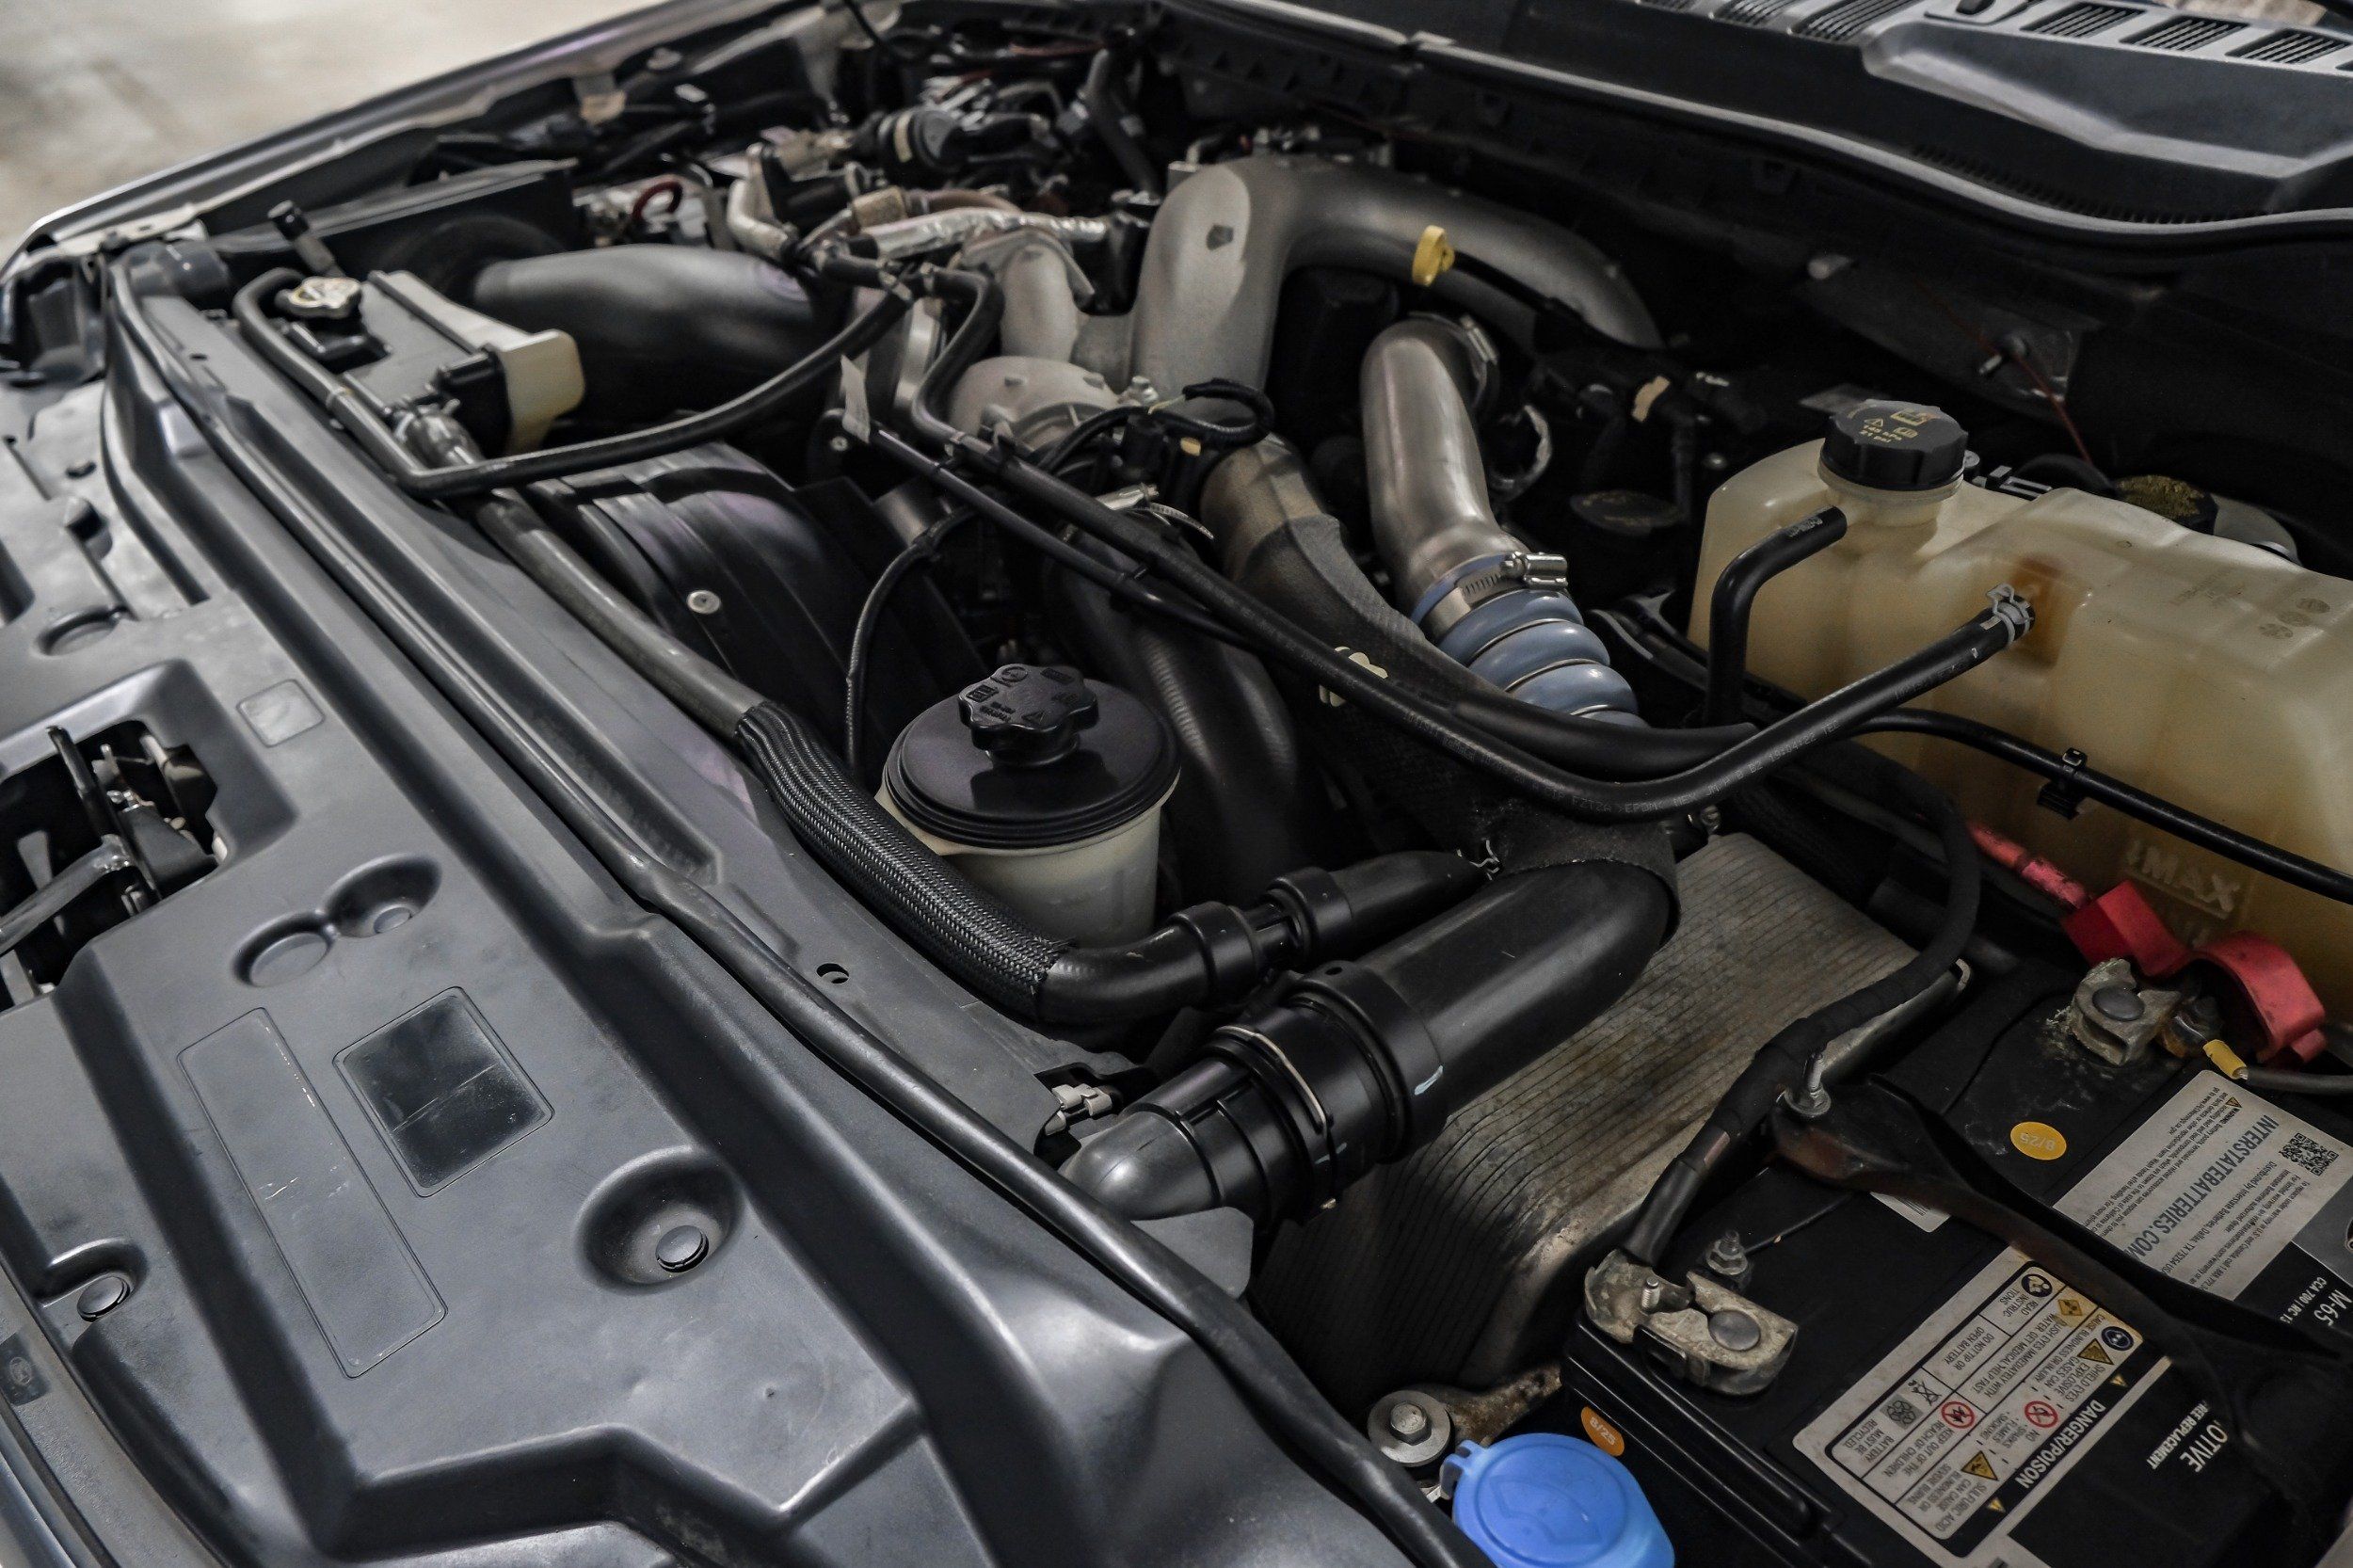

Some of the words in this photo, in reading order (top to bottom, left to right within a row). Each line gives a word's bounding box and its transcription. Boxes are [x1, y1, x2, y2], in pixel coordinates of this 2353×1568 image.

[2249, 1160, 2278, 1186] Distributed
[2269, 1169, 2291, 1188] Interstate
[2122, 1114, 2281, 1261] INTERSTATEBATTERIES.COM
[2242, 1181, 2255, 1191] by
[2253, 1185, 2274, 1203] Batteries
[2224, 1188, 2249, 1210] Interstate
[2082, 1213, 2097, 1226] inform
[2182, 1241, 2195, 1252] TX
[2168, 1248, 2187, 1265] 75254
[2310, 1277, 2327, 1291] CCA
[2299, 1289, 2315, 1304] 700
[2019, 1299, 2039, 1316] READ
[2288, 1304, 2302, 1316] RC
[2313, 1289, 2353, 1326] M-65
[2085, 1313, 2105, 1331] CAUSE
[1965, 1326, 1985, 1342] OPEN
[1981, 1333, 1994, 1343] DO
[2022, 1330, 2039, 1344] GET
[2032, 1335, 2051, 1351] EYES
[2057, 1329, 2089, 1357] BLINDNESS
[1969, 1340, 1986, 1354] NOT
[1999, 1340, 2027, 1366] MEDICAL
[1952, 1359, 1966, 1370] OR
[1961, 1351, 1975, 1362] TIP
[1997, 1347, 2038, 1384] IMMEDIATELY
[1984, 1363, 2004, 1380] HELP
[2055, 1355, 2080, 1377] GASES
[2078, 1363, 2105, 1387] SHIELD
[2043, 1374, 2060, 1389] CAN
[2053, 1362, 2089, 1396] EXPLOSIVE
[1982, 1380, 2004, 1398] WITH
[1919, 1419, 1945, 1442] REACH
[1978, 1413, 2009, 1440] SMOKING
[1991, 1419, 2018, 1444] FLAMES
[1863, 1428, 1885, 1447] MUST
[1912, 1438, 1926, 1448] OF
[1934, 1427, 1955, 1445] KEEP
[2001, 1425, 2026, 1448] SPARKS
[2013, 1398, 2106, 1489] DANGER/POISON
[2024, 1429, 2041, 1443] NO
[2145, 1415, 2197, 1469] REPLACEMENT
[1853, 1444, 1867, 1455] BE
[1922, 1441, 1940, 1456] OUT
[2178, 1418, 2231, 1475] OTIVE
[1913, 1453, 1928, 1464] OF
[1901, 1462, 1918, 1476] THE
[1954, 1478, 1972, 1494] CAN
[1935, 1490, 1960, 1512] CAUSE
[1949, 1481, 1987, 1516] SULFURIC
[1933, 1512, 1957, 1532] ACID
